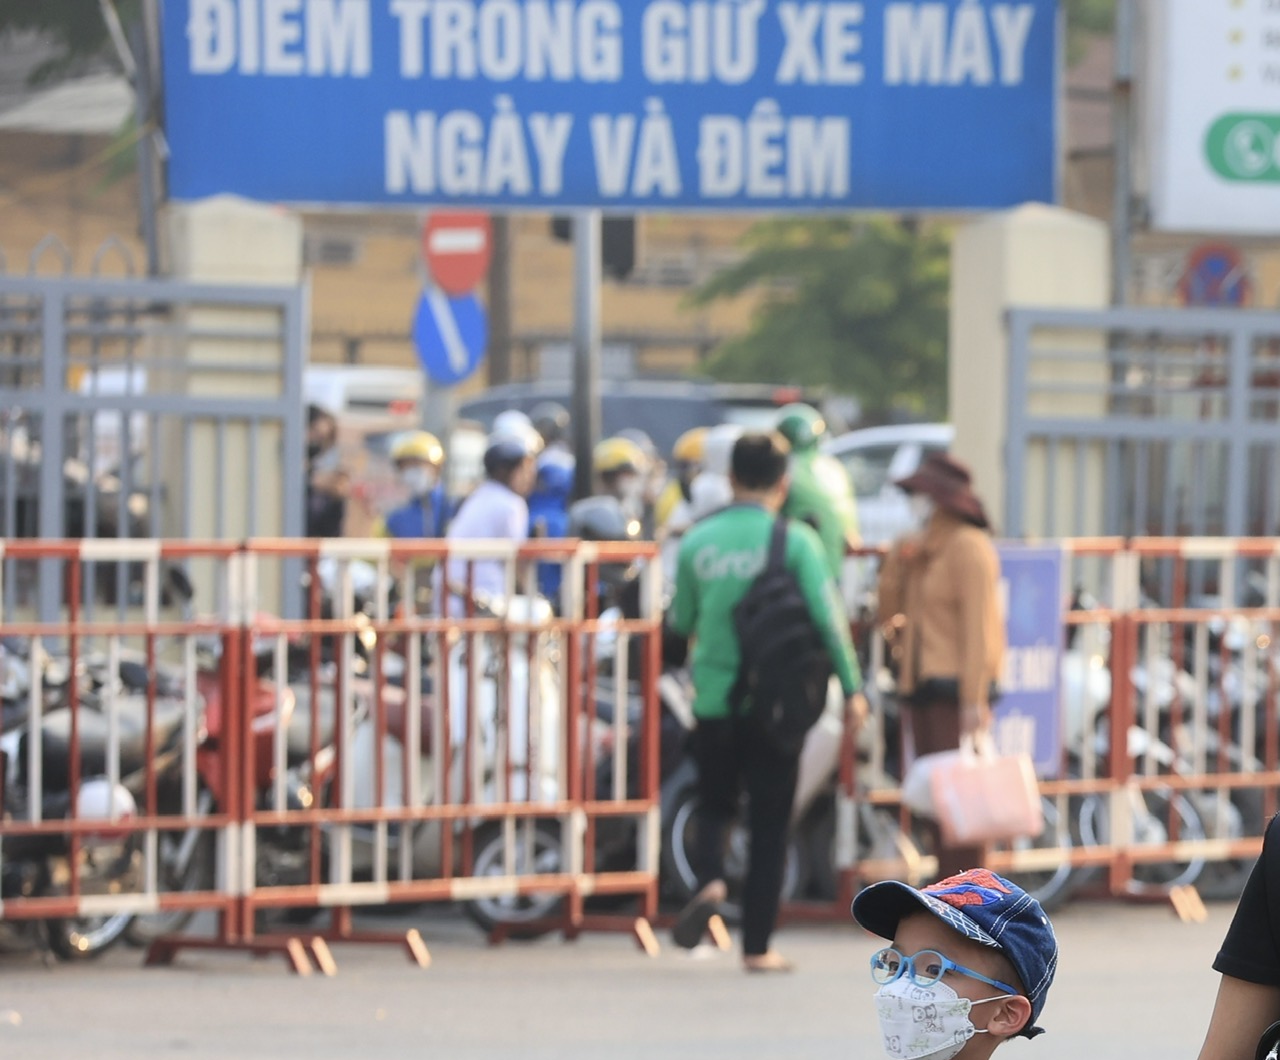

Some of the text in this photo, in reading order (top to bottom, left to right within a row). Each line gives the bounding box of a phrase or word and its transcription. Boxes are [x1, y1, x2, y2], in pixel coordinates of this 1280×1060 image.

[775, 3, 863, 85] XE
[384, 93, 849, 198] NGÀY VÀ ĐÊM
